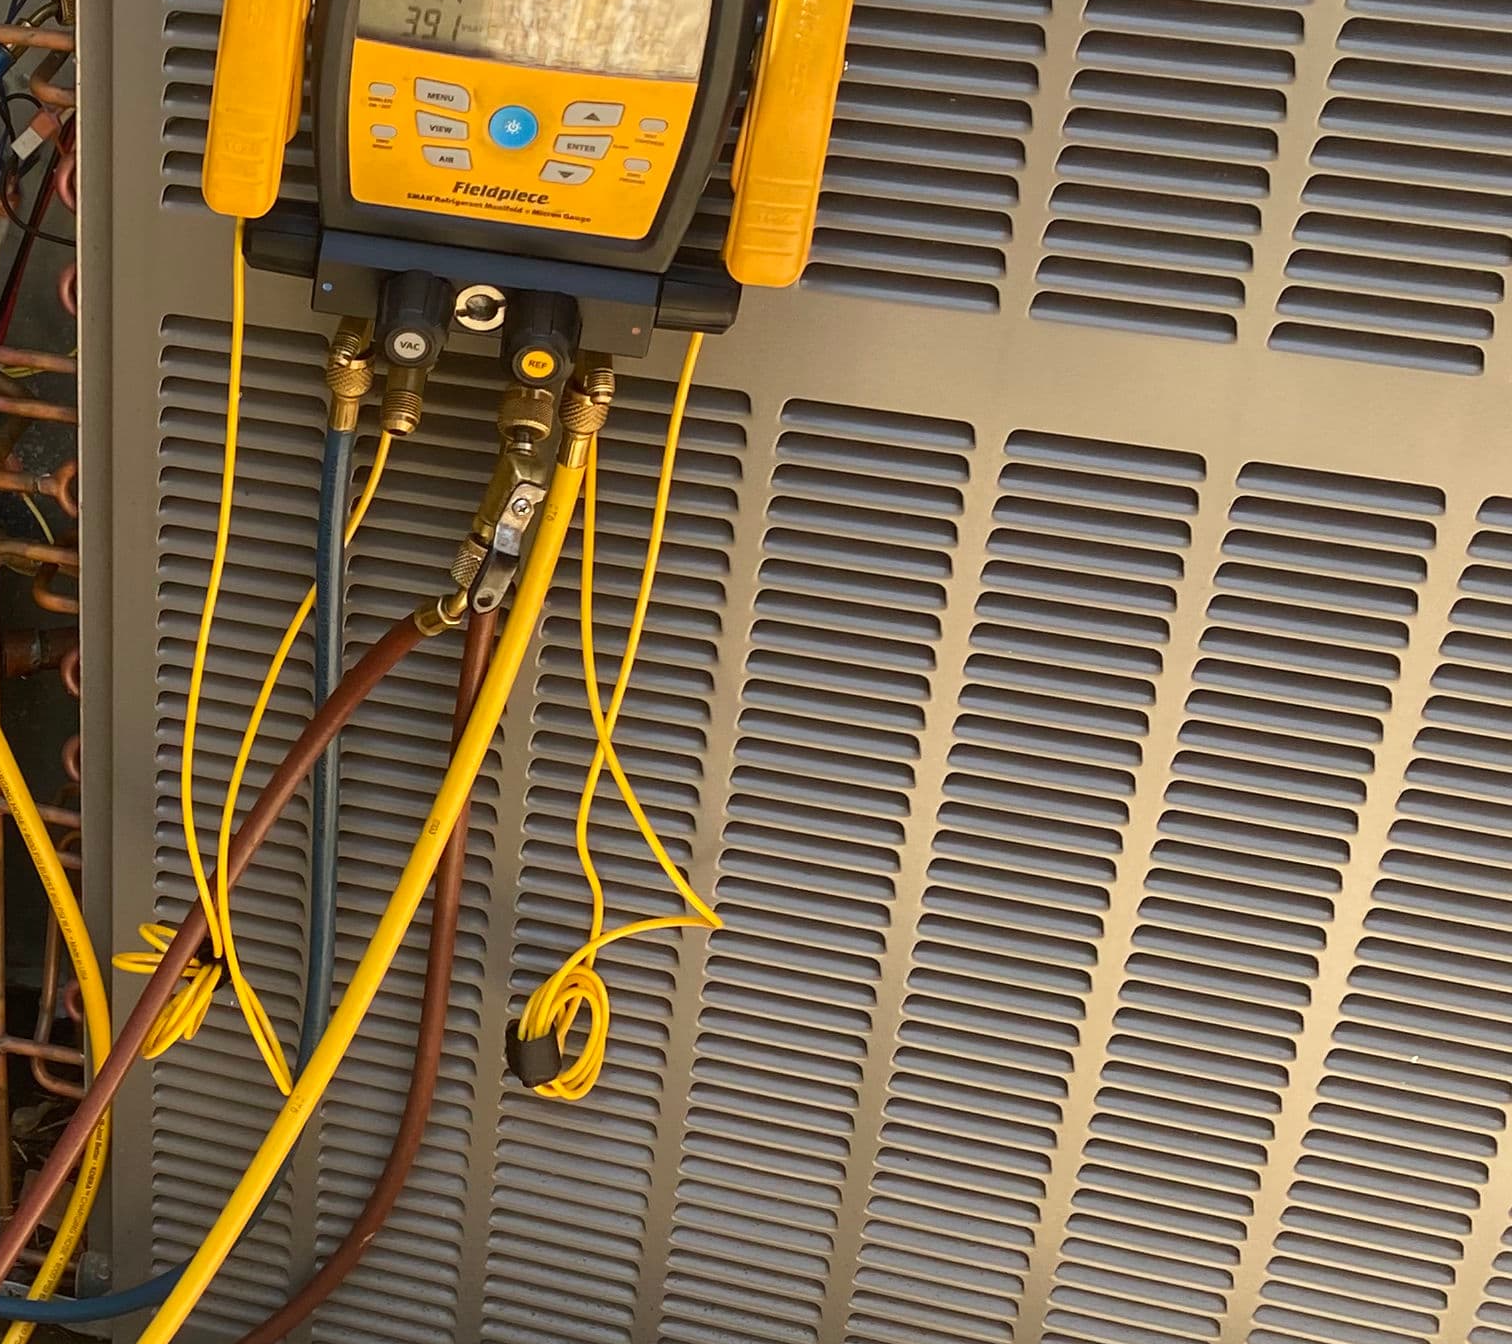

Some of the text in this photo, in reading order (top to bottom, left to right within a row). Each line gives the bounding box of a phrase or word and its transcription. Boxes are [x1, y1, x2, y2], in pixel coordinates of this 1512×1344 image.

[426, 92, 455, 103] MENU
[429, 124, 453, 134] VIEW
[566, 143, 596, 153] ENTER
[438, 155, 454, 164] AIR
[452, 181, 549, 204] Fieldpiece
[434, 195, 483, 208] Refrigerant
[484, 202, 523, 214] Manifold
[531, 209, 561, 219] Micron
[563, 213, 592, 223] Gauge
[399, 341, 420, 351] VAC
[527, 359, 548, 370] REF
[12, 807, 25, 828] HOSE
